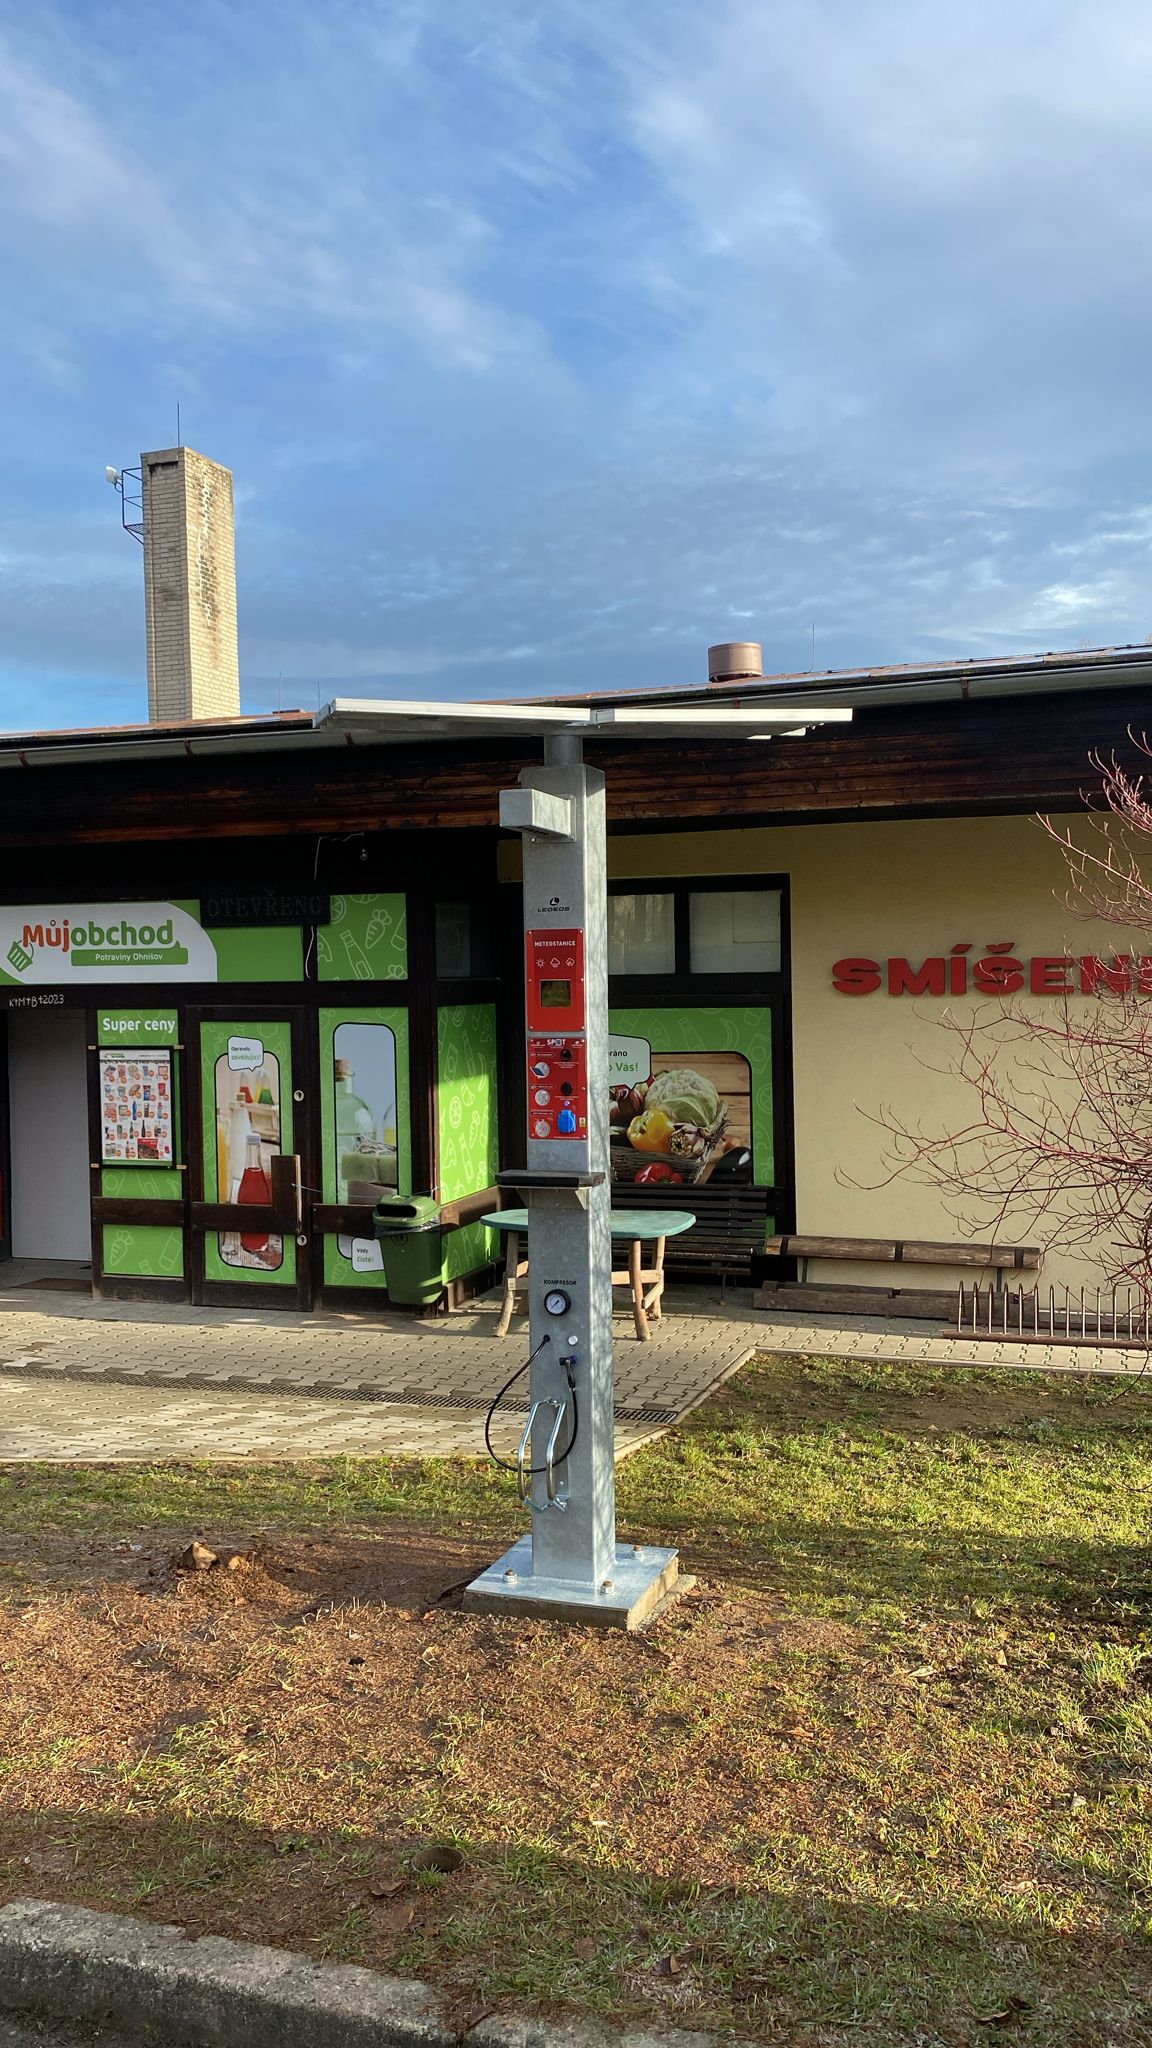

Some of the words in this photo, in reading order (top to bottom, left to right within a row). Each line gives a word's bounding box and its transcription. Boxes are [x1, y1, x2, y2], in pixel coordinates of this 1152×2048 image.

[207, 889, 320, 917] OTEVŘENO
[95, 953, 130, 962] Potraviny
[133, 952, 163, 961] Ohnišov
[102, 1018, 141, 1034] Super
[144, 1020, 176, 1034] ceny
[615, 1062, 639, 1072] Vás!
